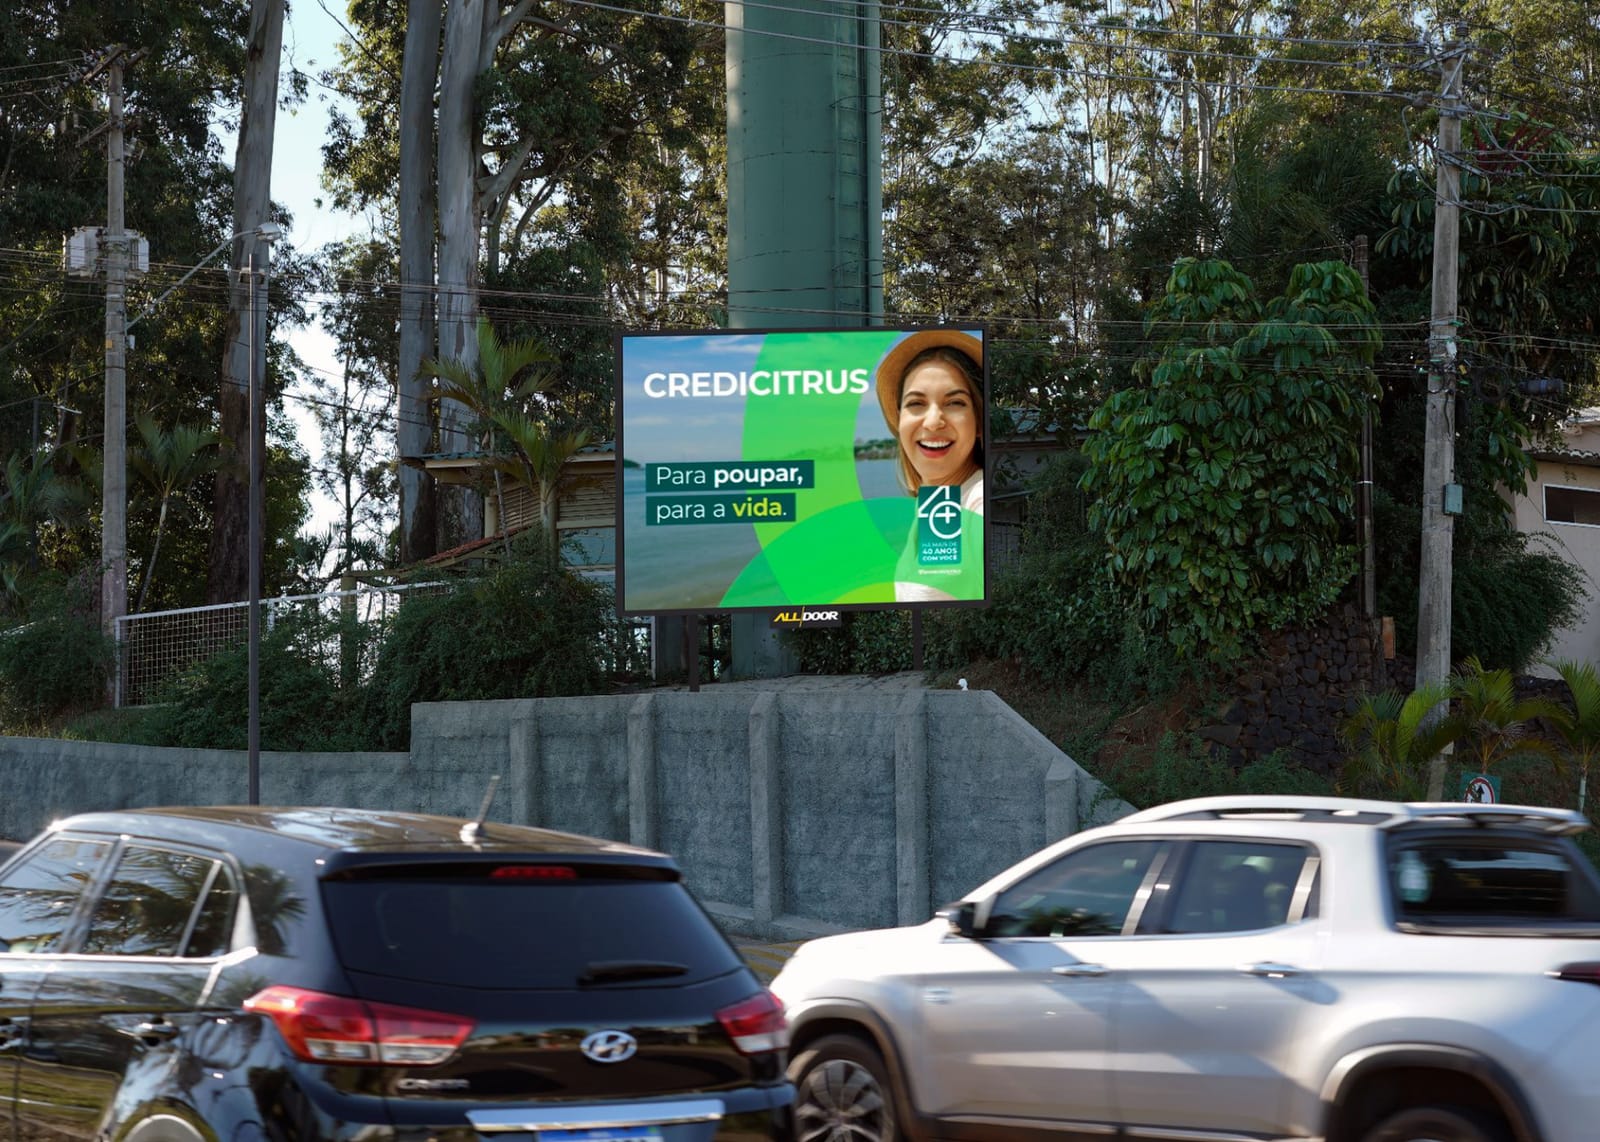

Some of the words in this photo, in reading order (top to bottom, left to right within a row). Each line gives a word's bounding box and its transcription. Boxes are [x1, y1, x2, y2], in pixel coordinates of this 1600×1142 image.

[643, 368, 870, 398] CREDICITRUS
[656, 466, 706, 485] Para
[714, 467, 804, 488] poupar,
[656, 503, 705, 524] para
[713, 503, 725, 517] a
[732, 497, 787, 517] vida.
[802, 611, 839, 621] DOOR
